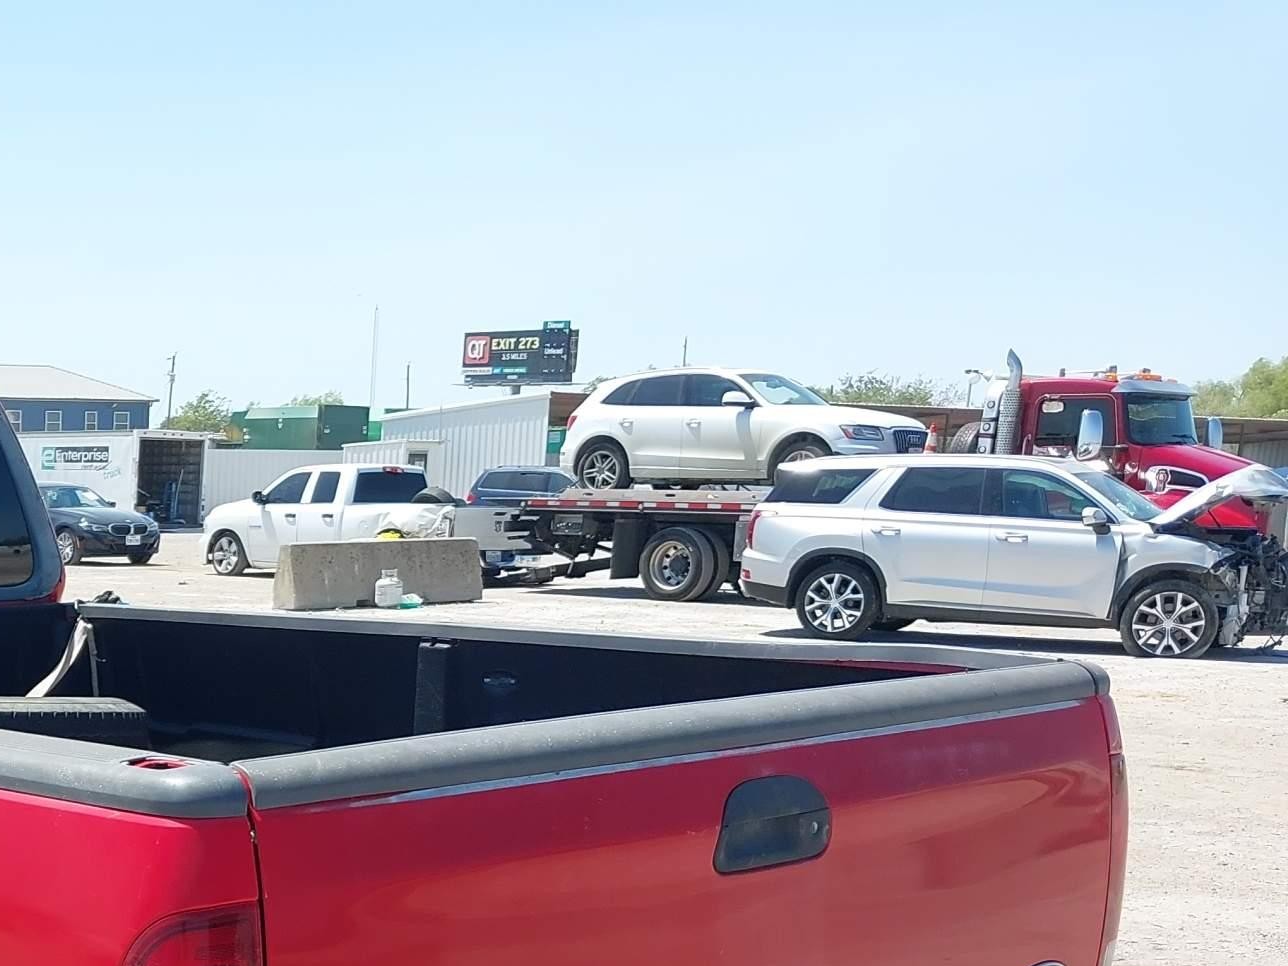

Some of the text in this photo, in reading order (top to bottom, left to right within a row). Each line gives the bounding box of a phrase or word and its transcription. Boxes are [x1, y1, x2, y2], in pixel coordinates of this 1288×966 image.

[468, 340, 485, 360] QT
[491, 337, 539, 350] EXIT 273
[55, 448, 109, 463] Enterprise
